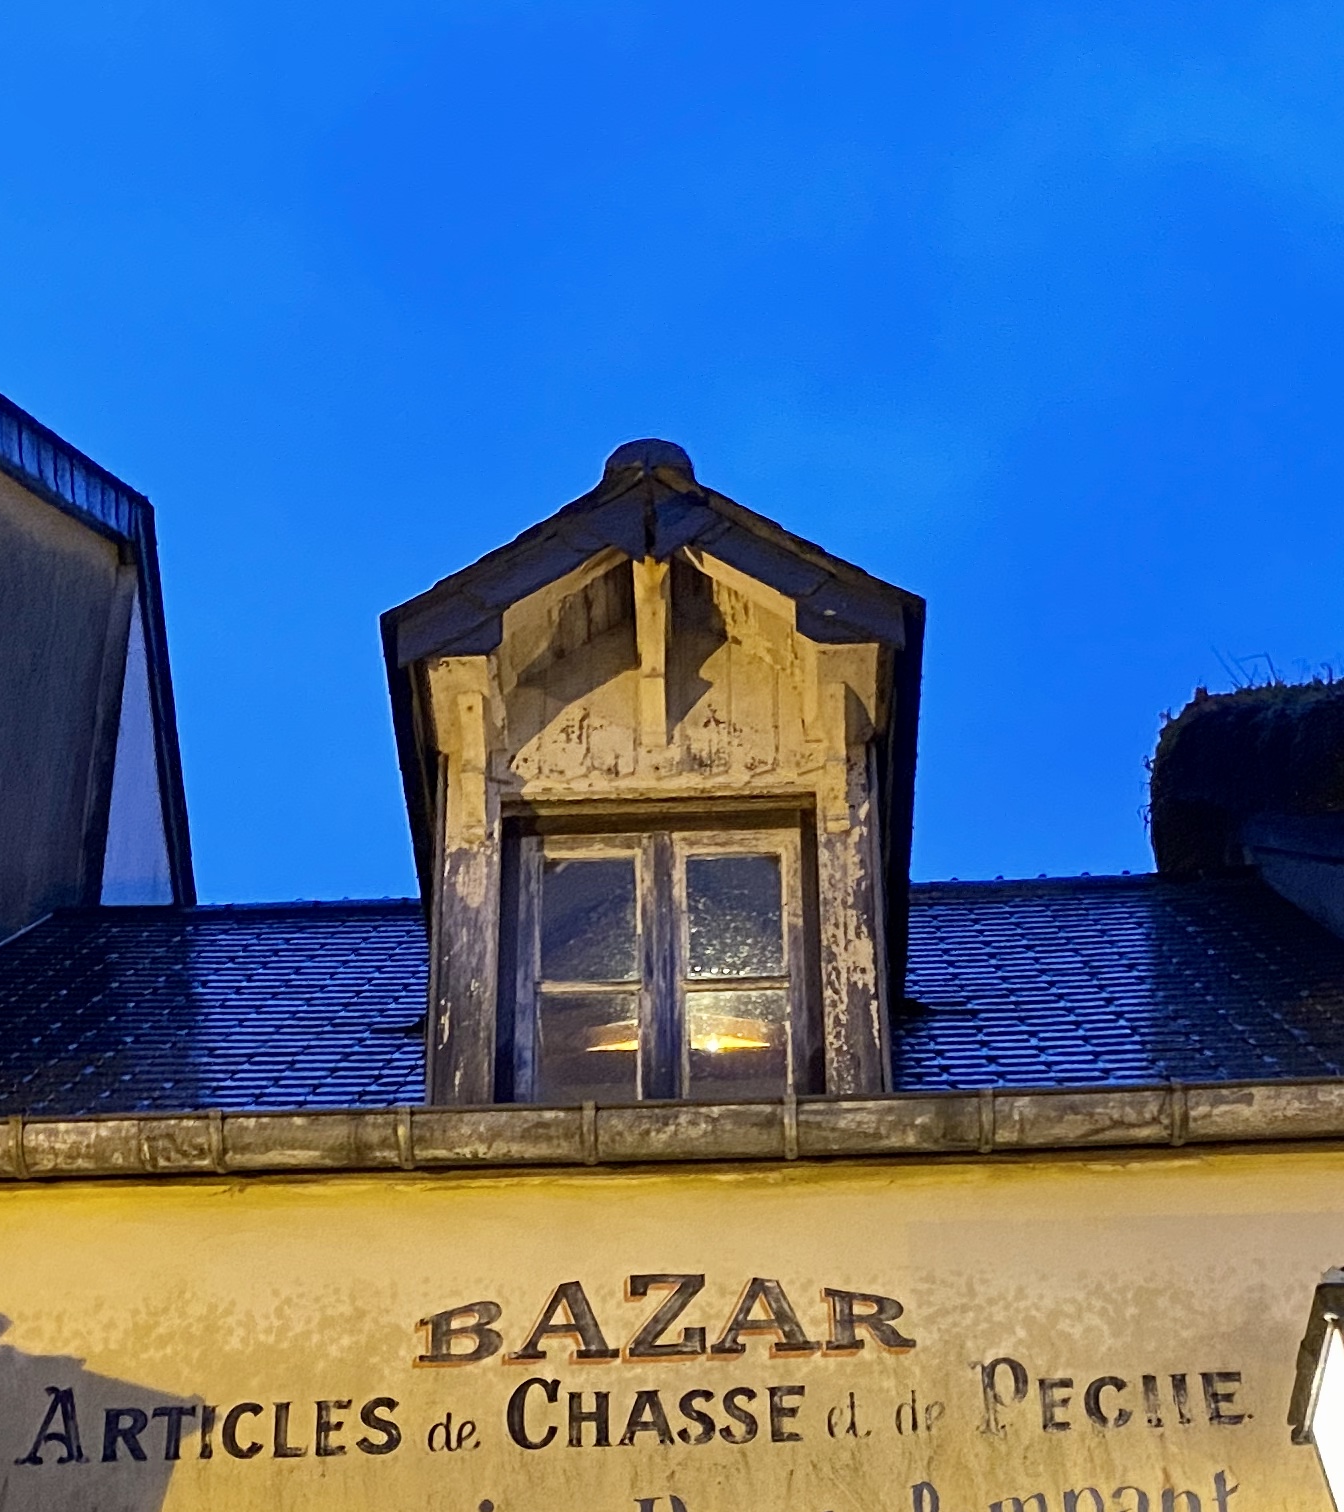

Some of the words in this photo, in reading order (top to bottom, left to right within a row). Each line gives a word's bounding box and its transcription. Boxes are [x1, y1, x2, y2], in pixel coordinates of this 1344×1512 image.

[413, 1273, 917, 1368] BAZAR
[14, 1386, 403, 1466] ARTICLES
[427, 1412, 481, 1453] de
[505, 1376, 807, 1452] CHASSE
[895, 1389, 947, 1438] de
